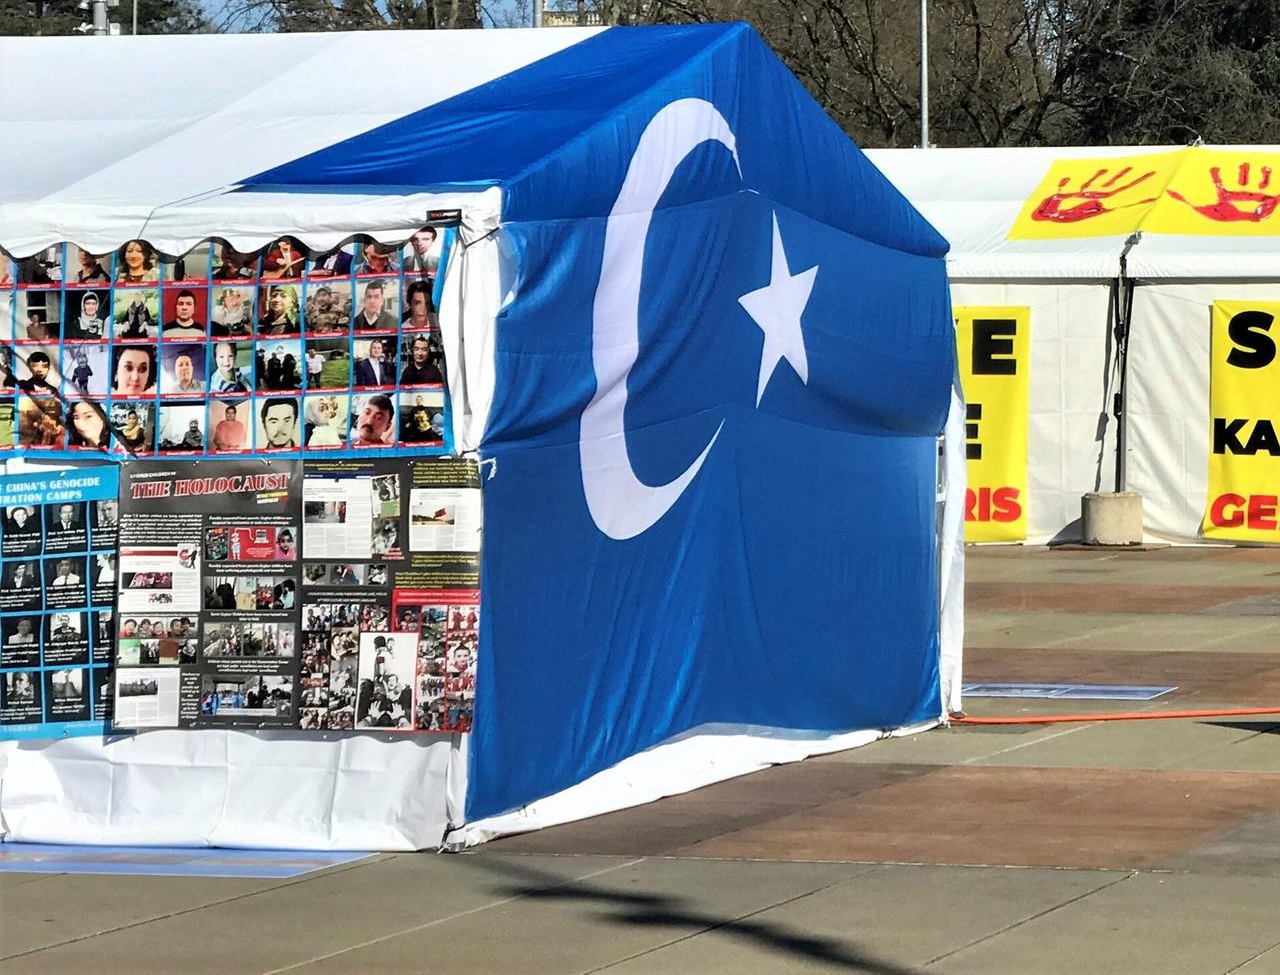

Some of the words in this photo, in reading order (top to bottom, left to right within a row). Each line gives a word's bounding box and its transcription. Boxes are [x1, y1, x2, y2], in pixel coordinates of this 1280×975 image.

[954, 319, 1017, 376] E
[6, 480, 46, 493] CHINA'S
[49, 477, 101, 489] GENOCIDE
[46, 490, 82, 500] CAMPS
[130, 481, 171, 499] THE
[174, 472, 291, 497] HOLOCAUST
